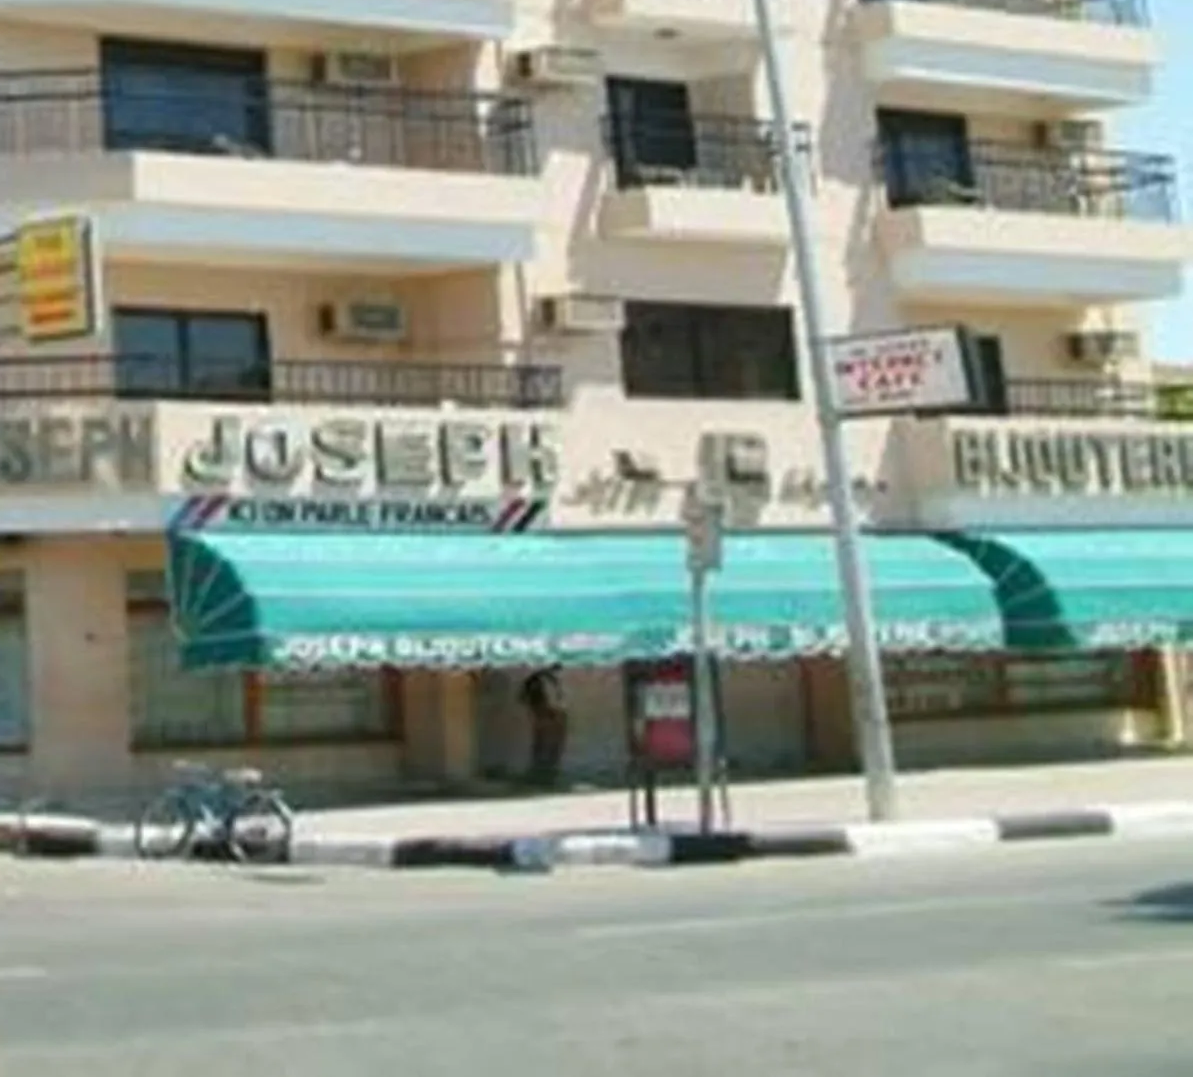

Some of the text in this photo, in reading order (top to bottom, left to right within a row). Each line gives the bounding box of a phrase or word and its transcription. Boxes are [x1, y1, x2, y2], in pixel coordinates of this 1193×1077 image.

[185, 414, 562, 487] JOSEPH
[262, 499, 296, 523] ON
[272, 632, 386, 660] JOSEPH
